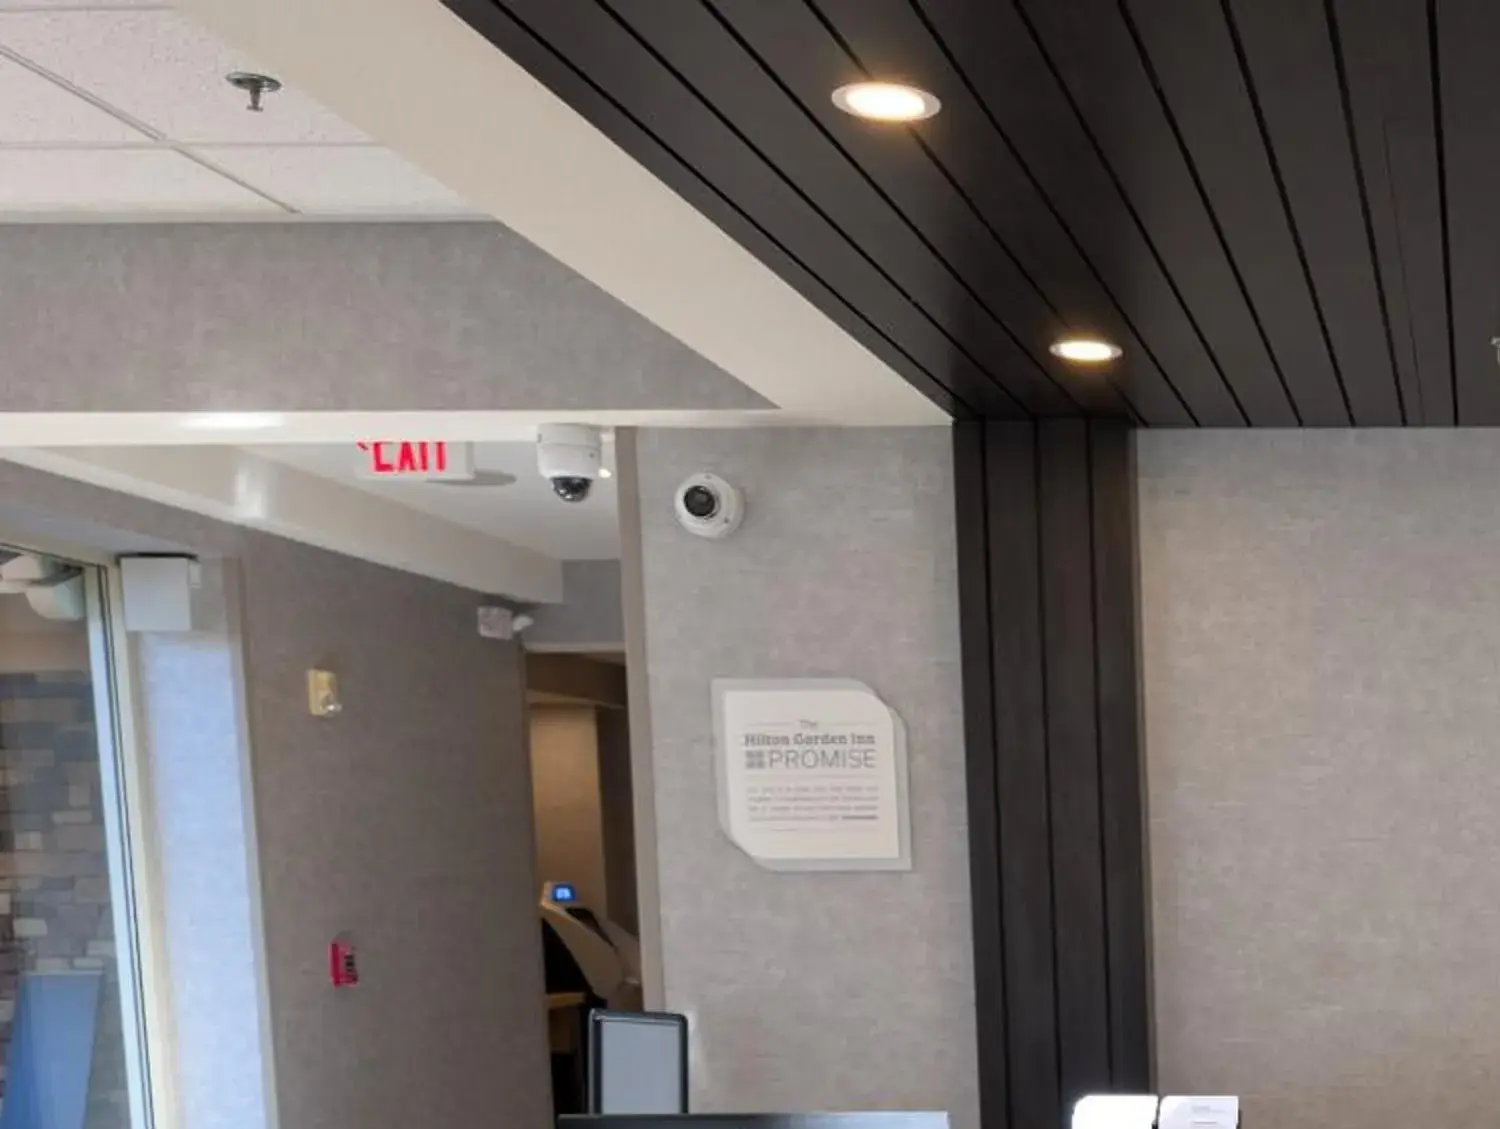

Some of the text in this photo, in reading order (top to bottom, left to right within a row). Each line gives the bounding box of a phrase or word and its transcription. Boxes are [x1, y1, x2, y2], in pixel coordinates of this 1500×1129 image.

[744, 732, 875, 746] Hilton Garden Inn
[768, 749, 877, 769] PROMISE
